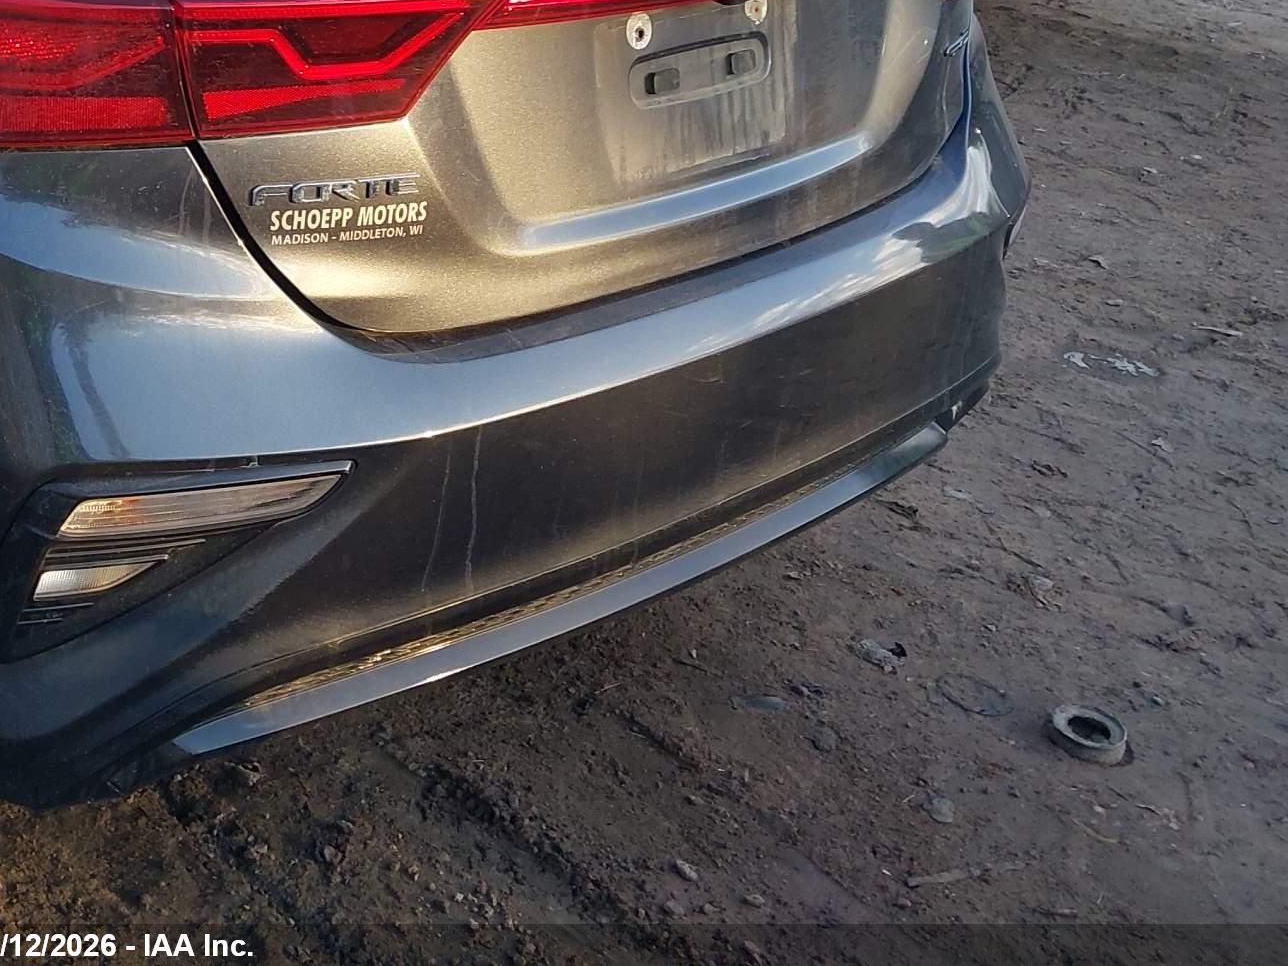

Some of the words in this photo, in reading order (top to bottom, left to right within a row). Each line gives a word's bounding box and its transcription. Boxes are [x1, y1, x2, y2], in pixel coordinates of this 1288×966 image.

[248, 172, 421, 206] FORTE
[270, 207, 353, 231] SCHOEPP
[357, 201, 428, 227] MOTORS
[271, 233, 329, 246] MADISON
[339, 226, 407, 242] MIDDLETON,
[409, 224, 424, 236] WI
